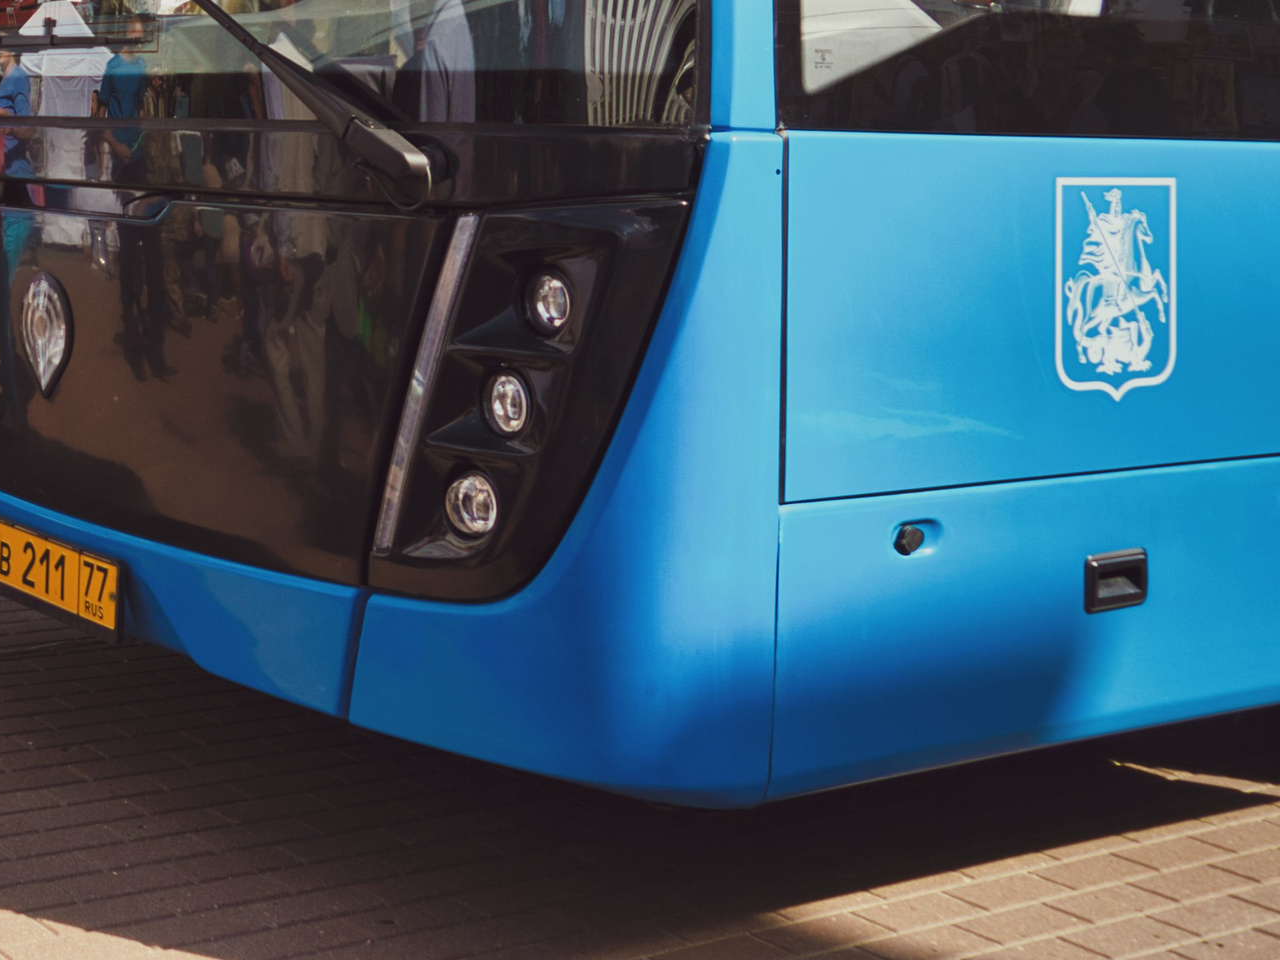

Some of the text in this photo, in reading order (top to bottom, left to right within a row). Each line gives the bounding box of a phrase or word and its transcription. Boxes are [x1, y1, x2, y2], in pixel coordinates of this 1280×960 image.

[21, 540, 66, 602] 211
[82, 560, 109, 603] 77
[84, 601, 104, 620] RUS
